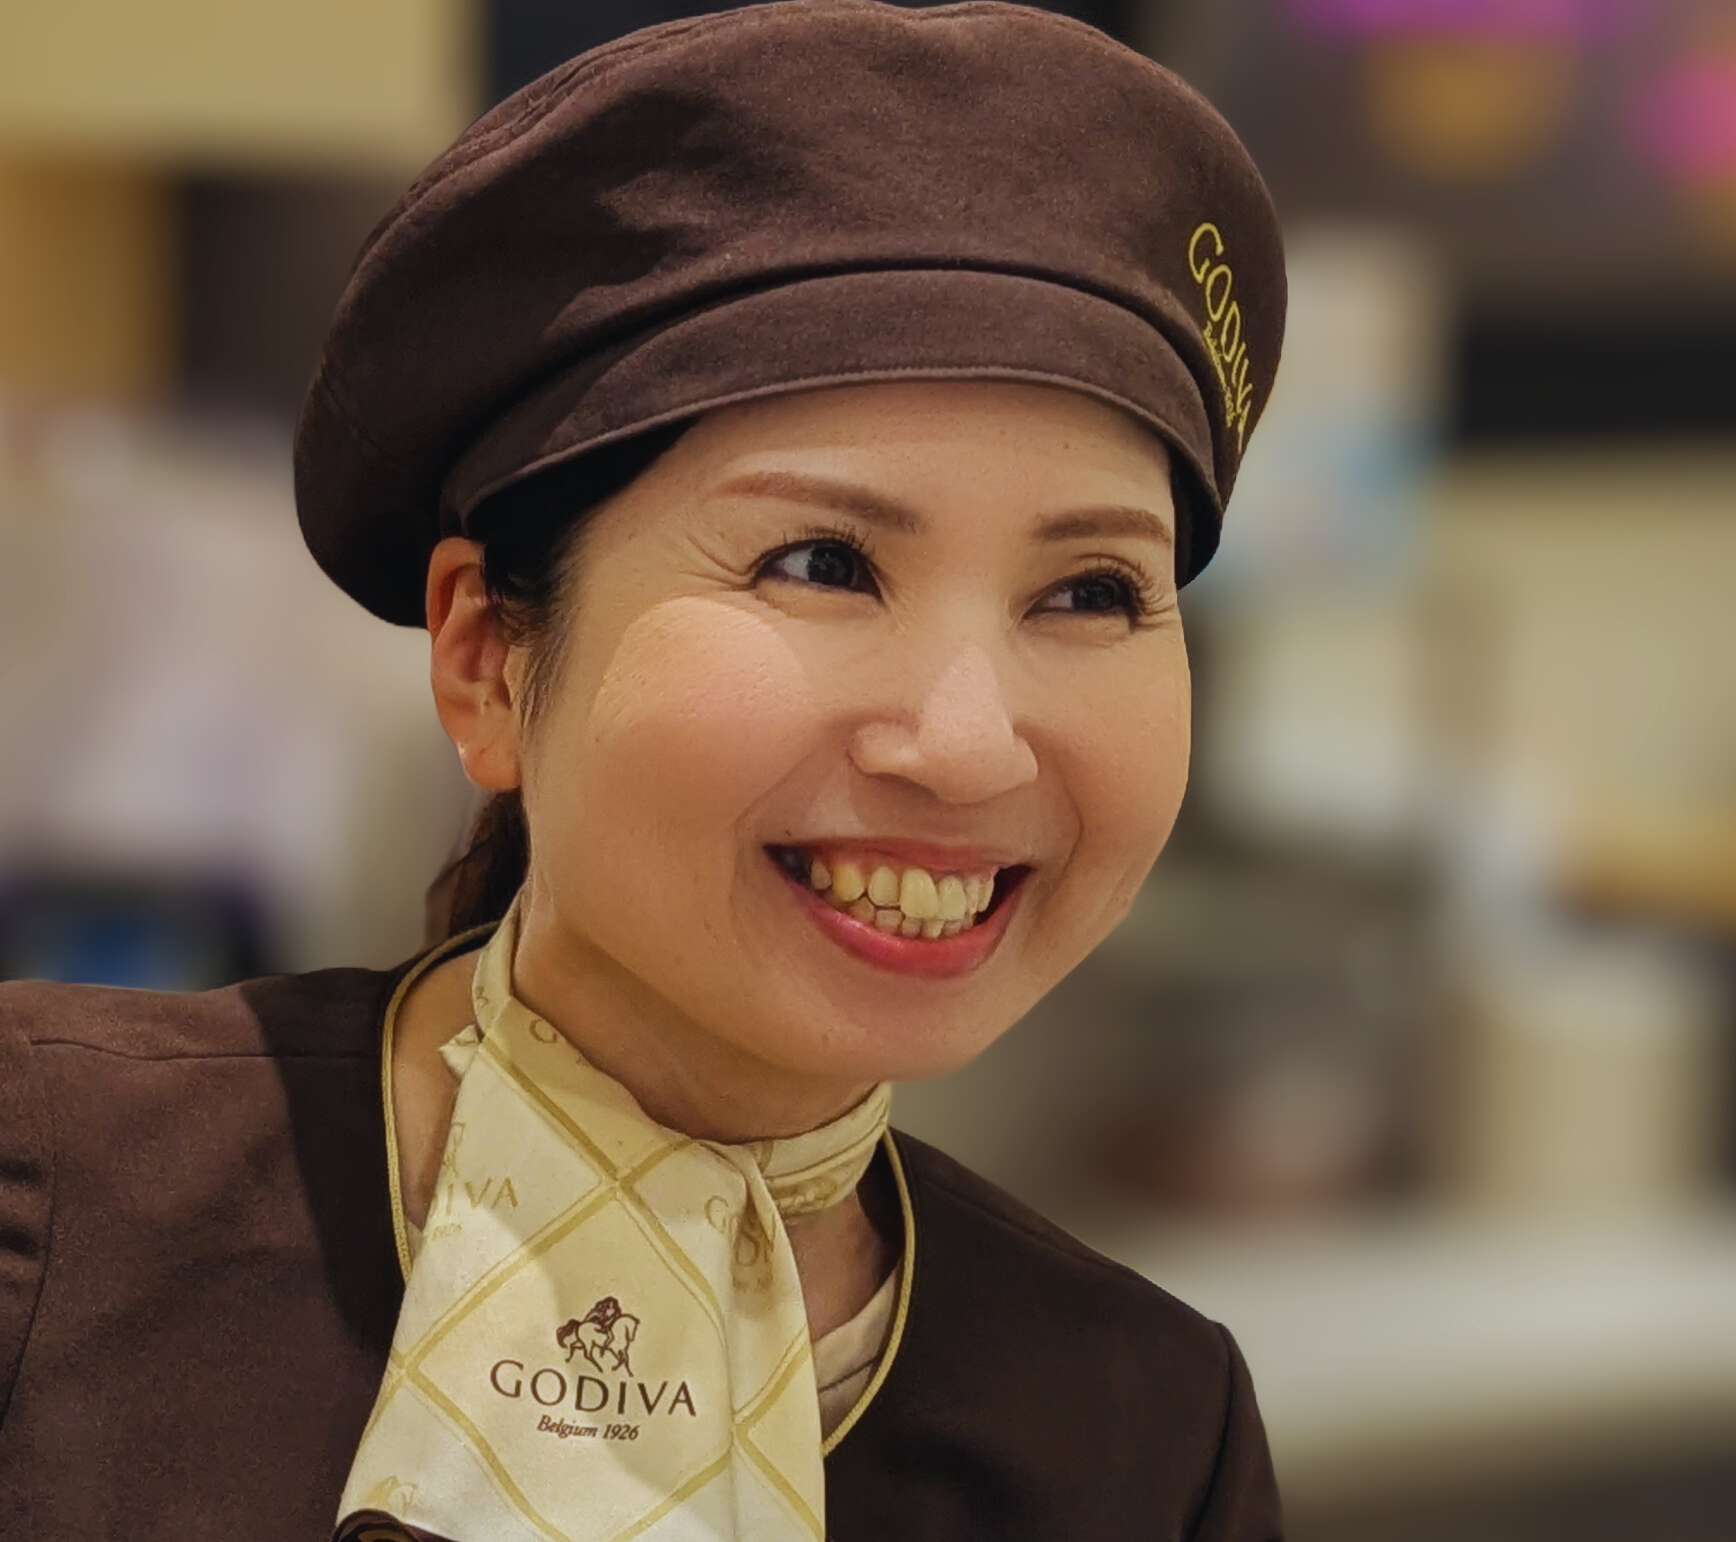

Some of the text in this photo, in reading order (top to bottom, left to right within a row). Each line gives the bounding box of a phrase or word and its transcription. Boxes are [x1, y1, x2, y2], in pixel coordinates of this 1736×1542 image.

[432, 1177, 519, 1216] IVA
[490, 1358, 696, 1417] GODIVA
[537, 1414, 641, 1441] Belgium 1926
